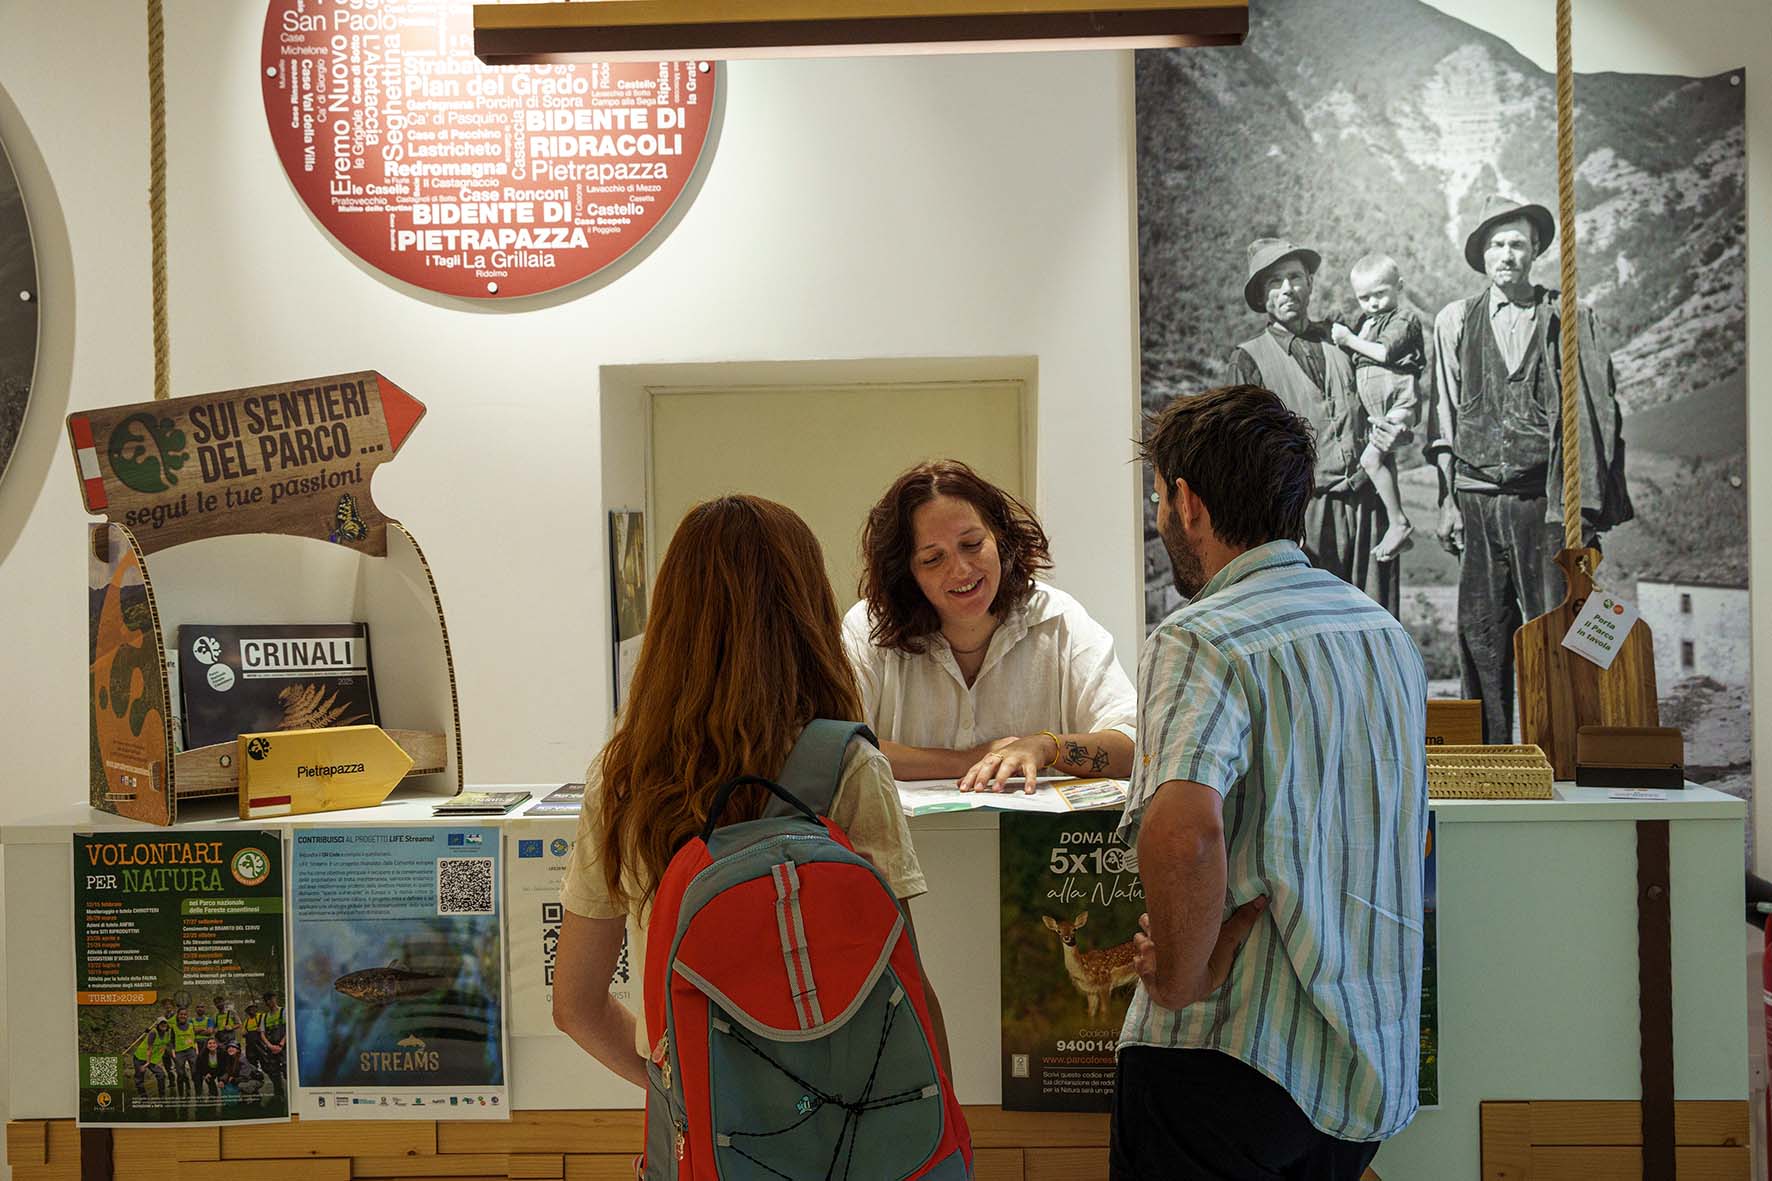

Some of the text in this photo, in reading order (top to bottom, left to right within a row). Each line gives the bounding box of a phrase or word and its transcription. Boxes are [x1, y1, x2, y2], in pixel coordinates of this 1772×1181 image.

[283, 10, 325, 31] San
[334, 10, 398, 31] Paolo
[280, 33, 305, 42] Case
[363, 34, 383, 146] L'Abetaccia
[404, 76, 459, 97] Plan
[466, 75, 504, 97] del
[512, 74, 589, 96] Grado
[617, 79, 657, 90] Castello
[657, 62, 671, 105] Ripian
[686, 62, 697, 105] la Grati
[318, 94, 326, 104] di
[381, 33, 407, 161] Seghettina
[476, 95, 584, 112] Porcini di Sopra
[302, 59, 316, 171] Case Val della Villa
[328, 34, 354, 195] Eremo Nuovo
[433, 111, 445, 124] di
[449, 110, 510, 127] Pasquino
[527, 107, 686, 131] BIDENTE DI
[437, 130, 449, 139] di
[408, 141, 502, 157] Lastricheto
[531, 134, 683, 158] RIDRACOLI
[352, 158, 365, 168] le
[384, 161, 508, 179] Redromagna
[531, 158, 668, 186] Pietrapazza
[353, 183, 410, 196] le Caselle
[459, 186, 570, 202] Case Ronconi
[627, 184, 635, 192] di
[331, 197, 387, 206] Pratovecchio
[588, 203, 645, 216] Castello
[413, 201, 573, 226] BIDENTE DI
[397, 226, 590, 252] PIETRAPAZZA
[433, 256, 462, 272] Tagli
[463, 247, 557, 270] La Grillaia
[190, 381, 370, 445] SUI SENTIERI
[197, 439, 257, 483] DEL
[260, 422, 352, 473] PARCO
[125, 463, 363, 529] segui le tue passioni
[1593, 614, 1616, 630] Porta
[1576, 628, 1612, 652] in tavola
[1591, 624, 1615, 641] Parco
[244, 640, 352, 668] CRINALI
[1425, 735, 1445, 746] ma
[297, 762, 365, 779] Pietrapazza
[298, 836, 344, 845] CONTRIBUISCI
[356, 835, 388, 844] PROGETTO
[389, 835, 404, 843] LIFE
[1060, 832, 1104, 845] DONA
[85, 842, 223, 866] VOLONTARI
[86, 867, 225, 893] PER NATURA
[1047, 874, 1145, 906] alla Natu
[1080, 1029, 1109, 1039] Codice
[360, 1051, 440, 1072] STREAMS
[1042, 1056, 1116, 1066] www.parcofores
[1060, 1071, 1080, 1080] questo
[1043, 1088, 1052, 1096] per
